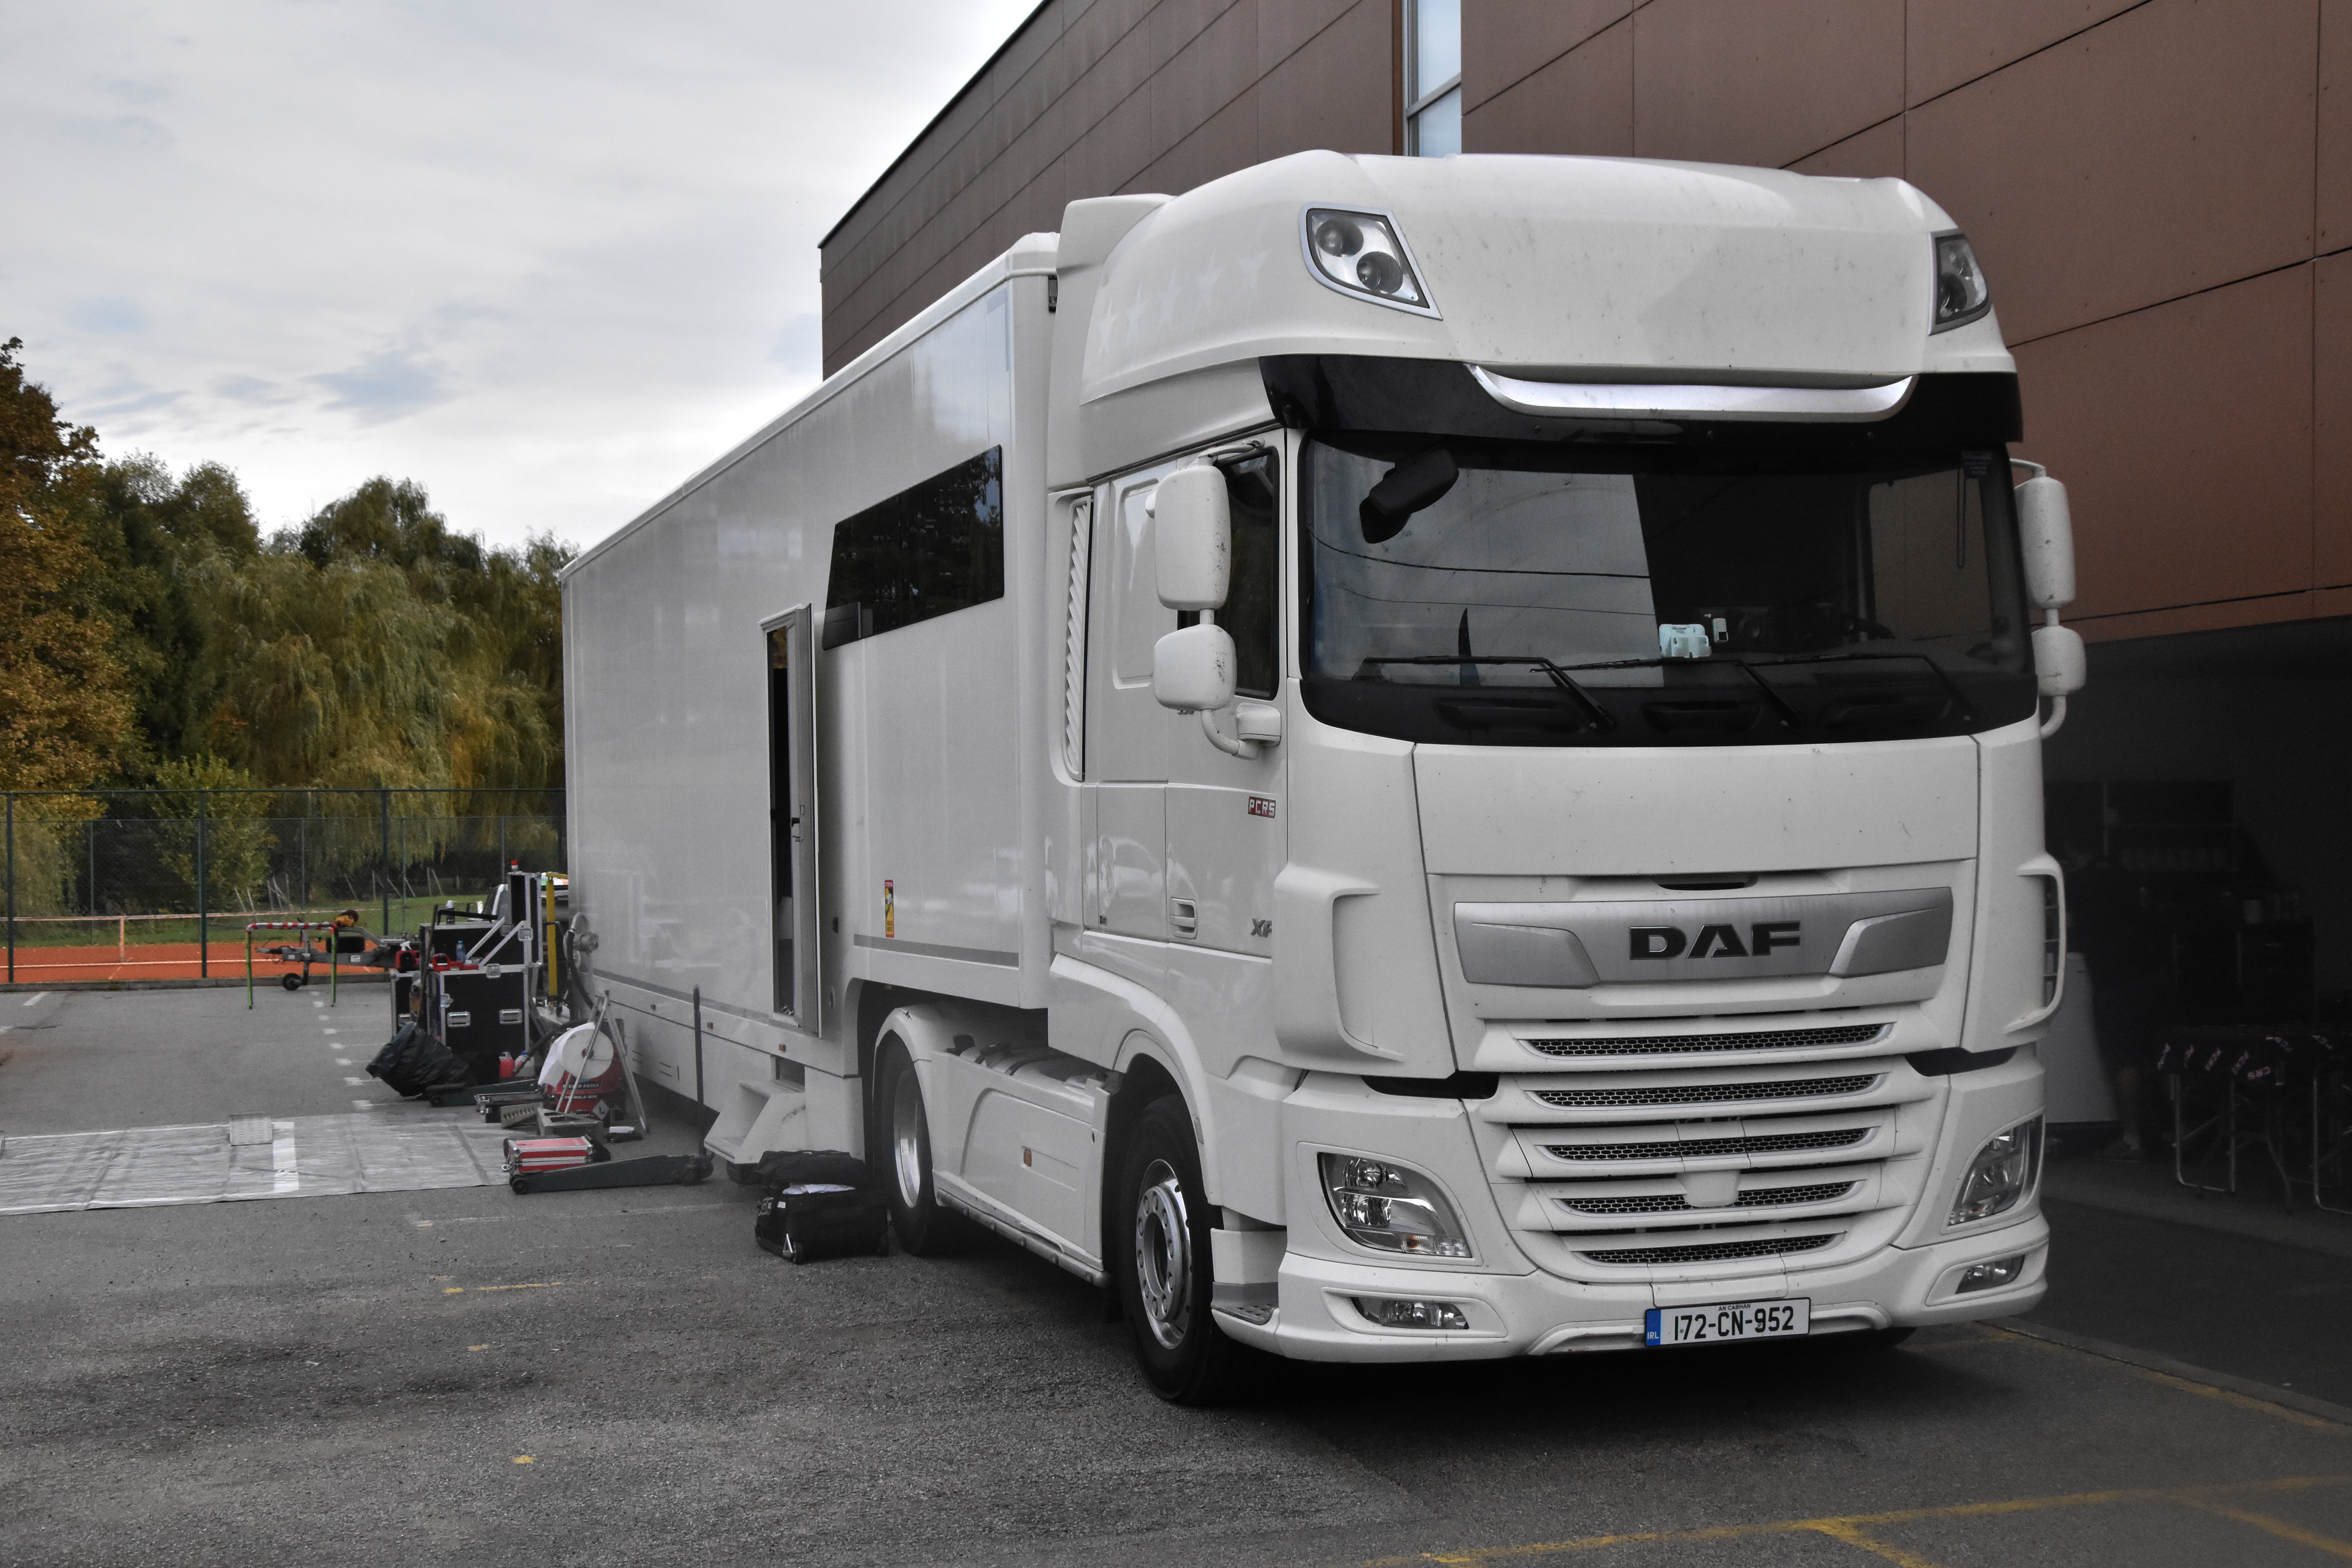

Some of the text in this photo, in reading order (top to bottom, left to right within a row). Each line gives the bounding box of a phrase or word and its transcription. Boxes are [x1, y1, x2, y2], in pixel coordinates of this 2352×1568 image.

[1249, 799, 1275, 816] PCRS
[1629, 921, 1800, 960] DAF
[1647, 1331, 1659, 1340] IRL
[1674, 1306, 1794, 1341] 172-CN-952
